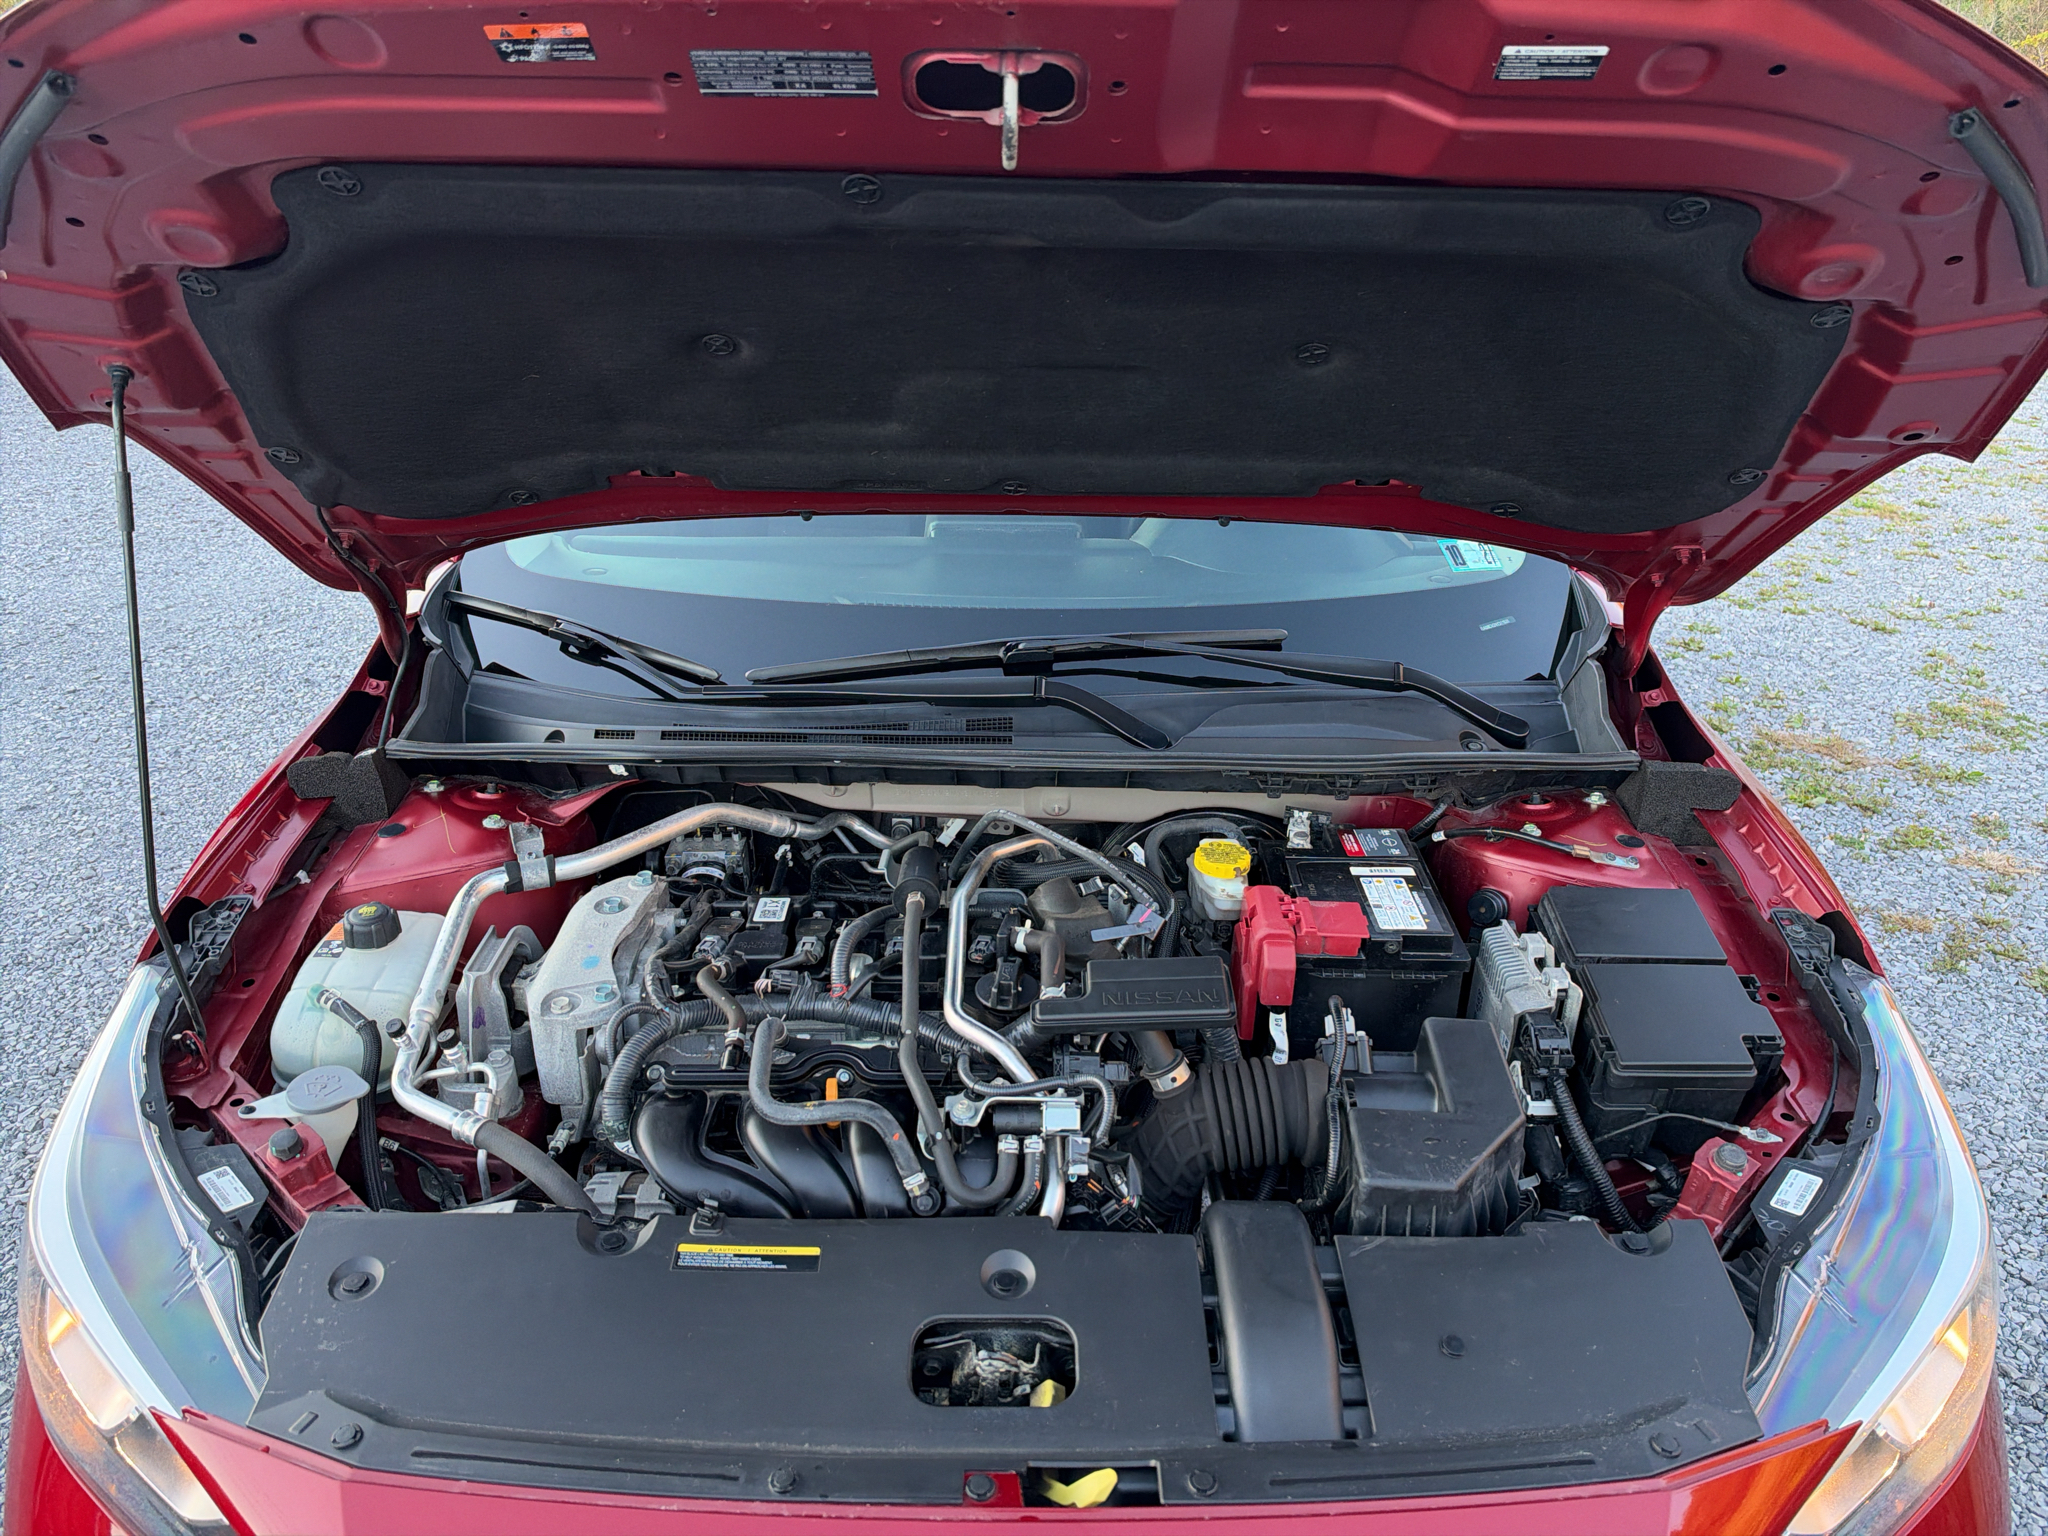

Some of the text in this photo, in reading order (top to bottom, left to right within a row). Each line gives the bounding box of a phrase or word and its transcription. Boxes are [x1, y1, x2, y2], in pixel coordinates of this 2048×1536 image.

[1444, 544, 1467, 566] 10
[1102, 988, 1221, 1006] NISSAN
[382, 1138, 396, 1150] B6
